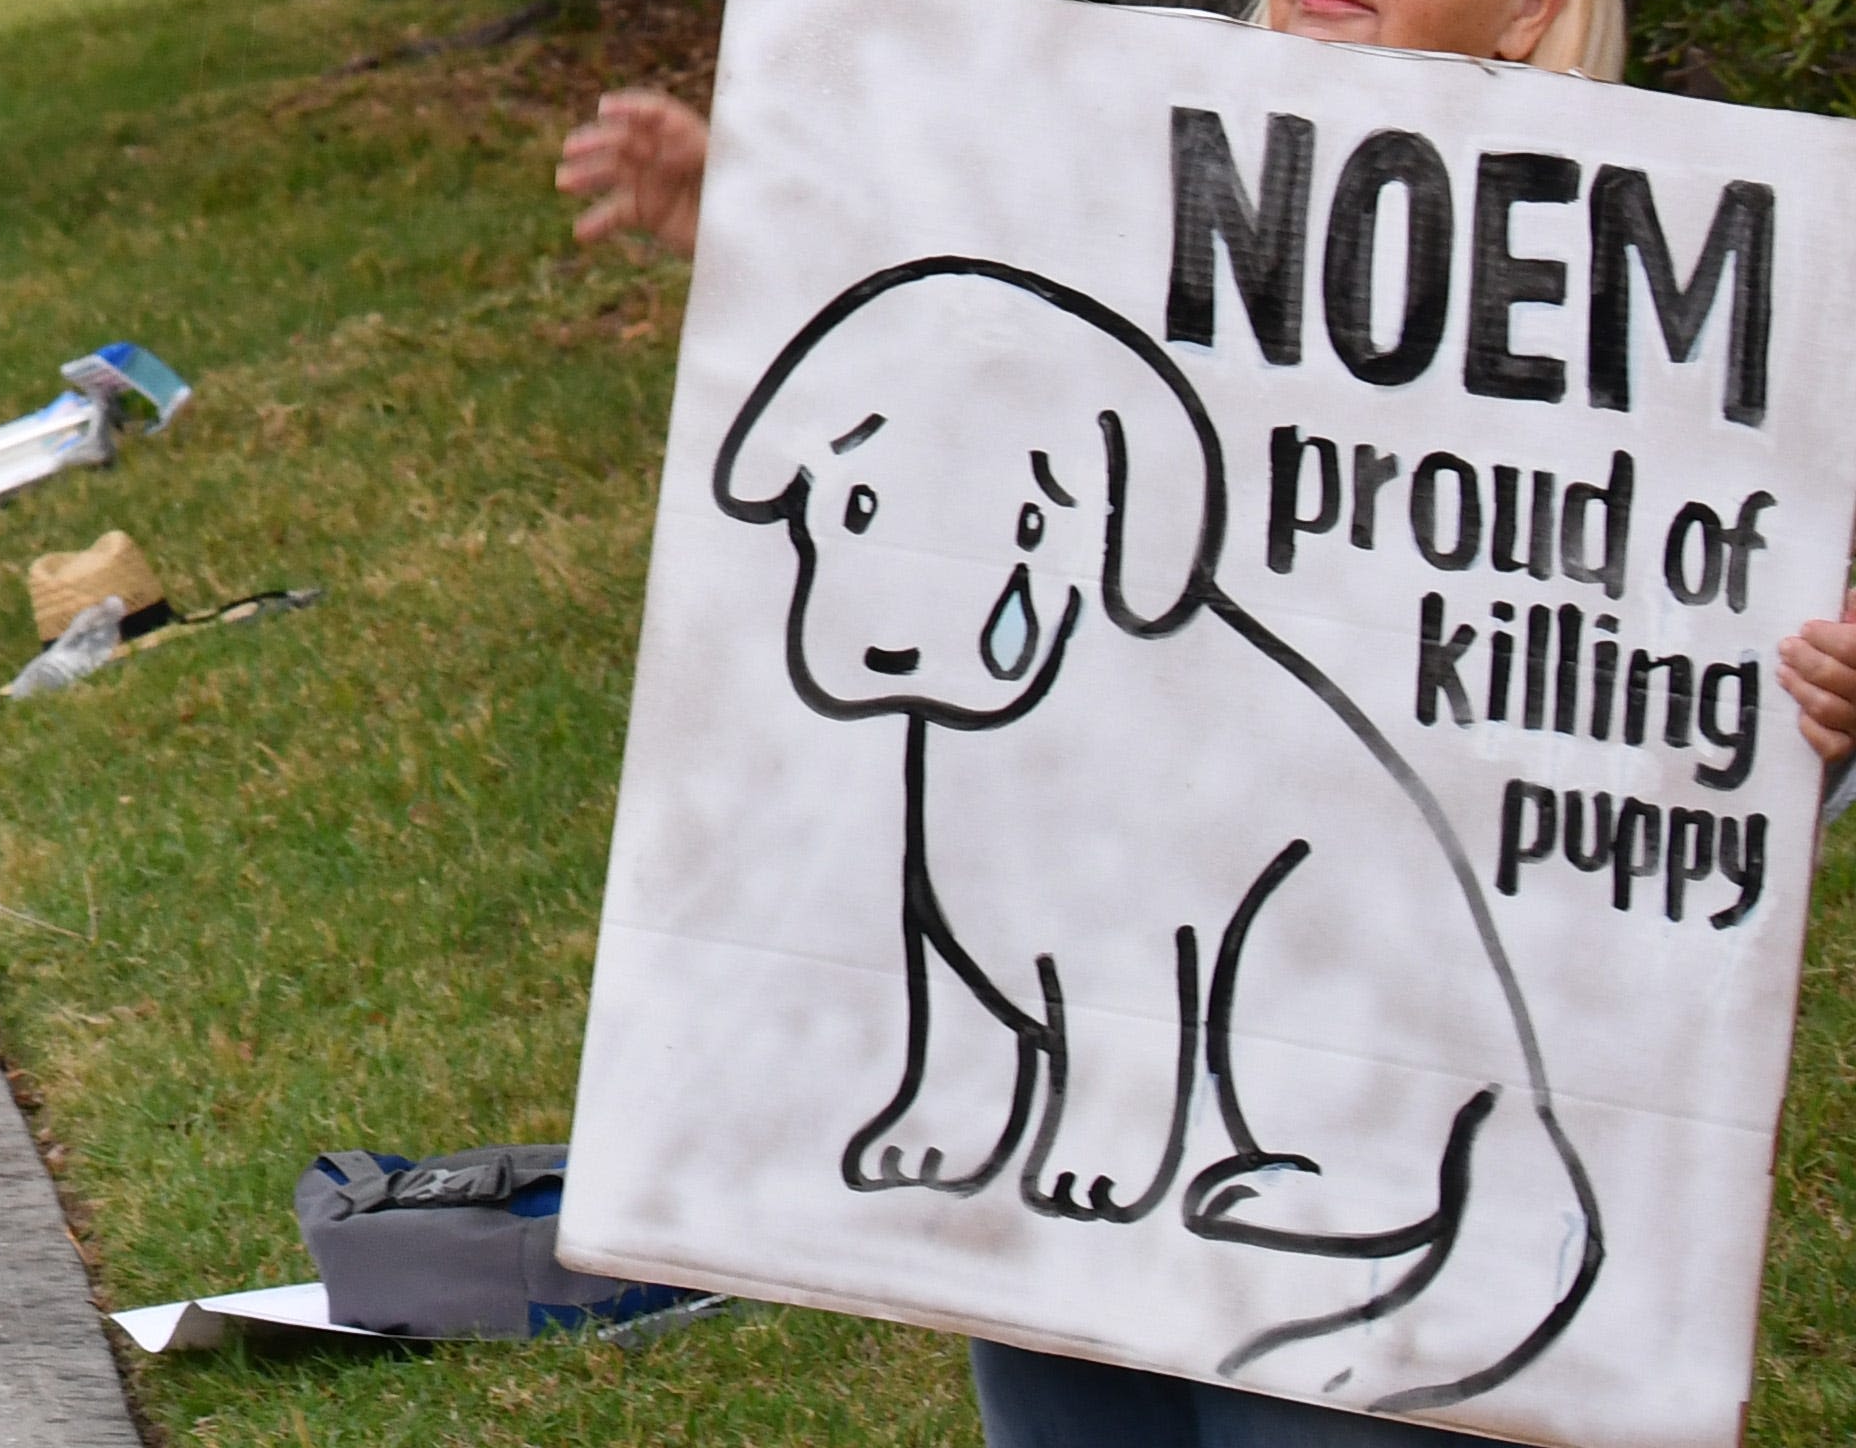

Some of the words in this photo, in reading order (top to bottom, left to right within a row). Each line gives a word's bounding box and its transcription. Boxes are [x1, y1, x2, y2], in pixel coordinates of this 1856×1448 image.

[1164, 105, 1777, 428] NOEM
[1266, 422, 1635, 602] proud
[1663, 492, 1778, 615] of
[1414, 591, 1761, 792] killing
[1495, 776, 1772, 930] puppy
